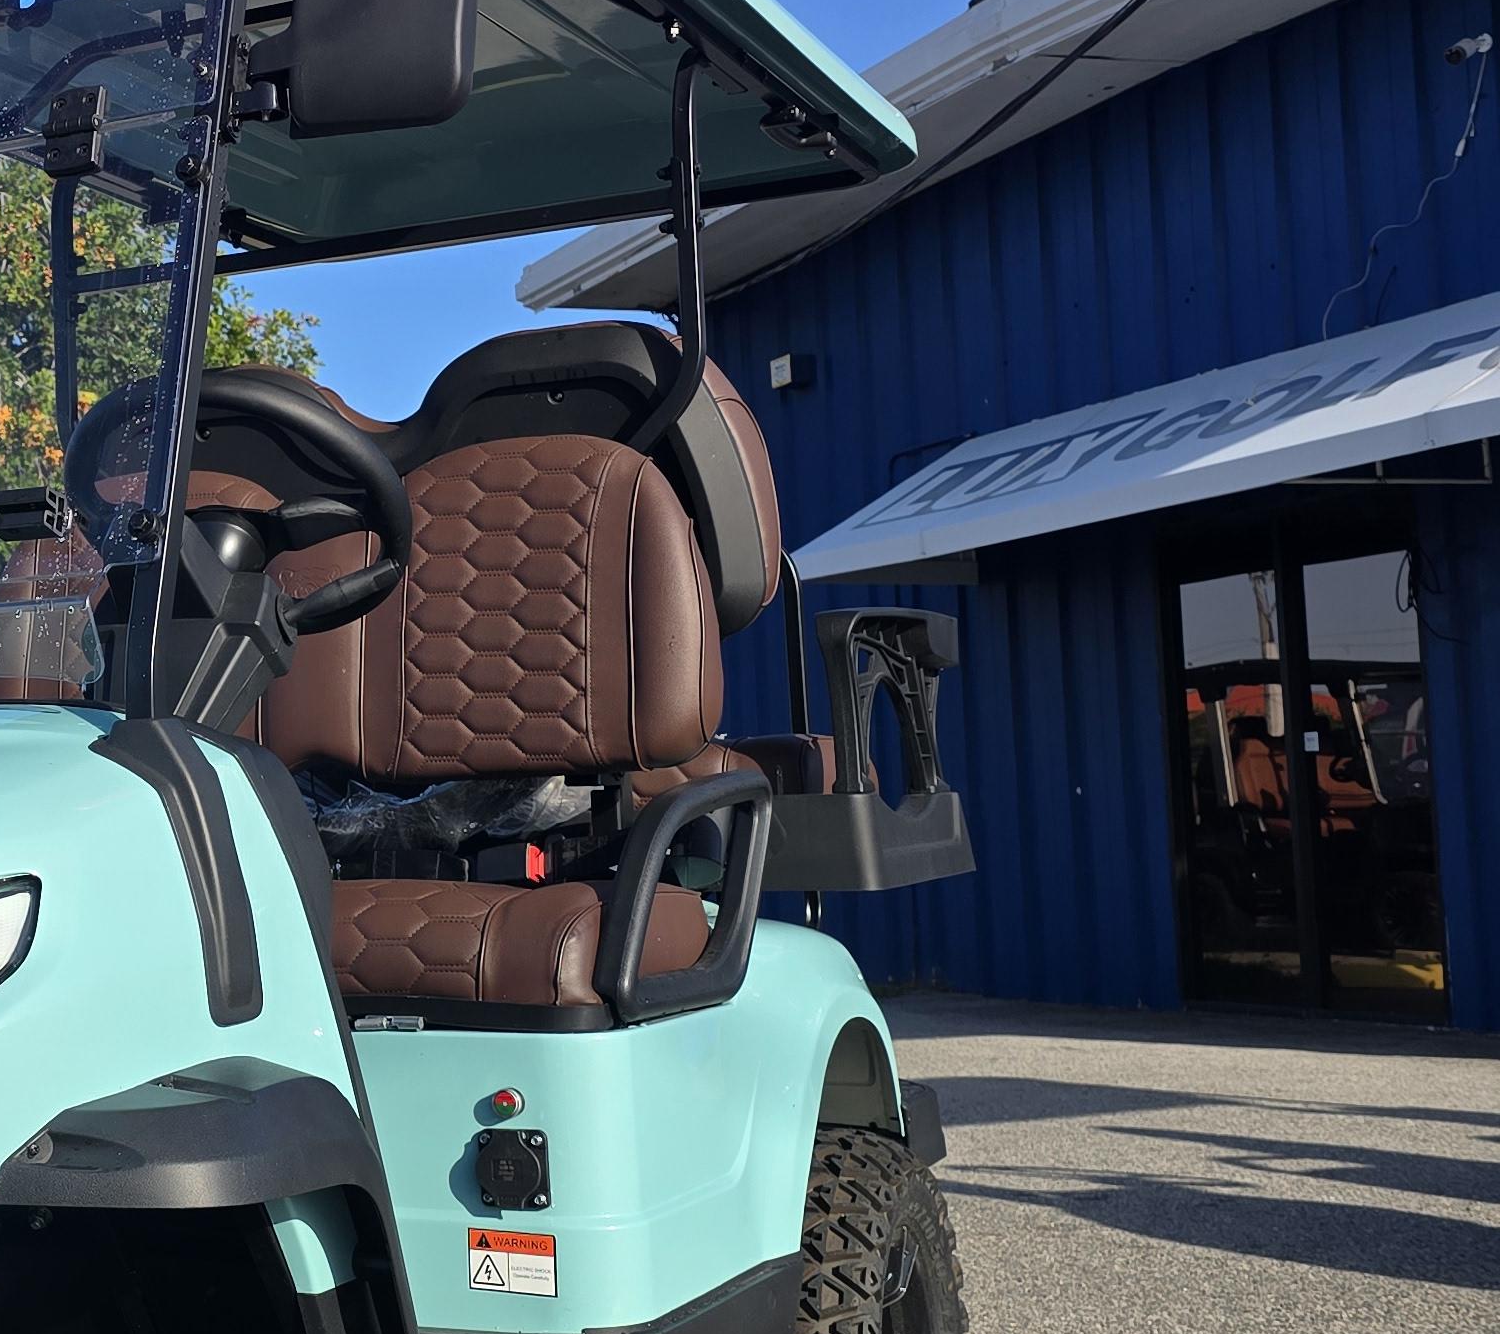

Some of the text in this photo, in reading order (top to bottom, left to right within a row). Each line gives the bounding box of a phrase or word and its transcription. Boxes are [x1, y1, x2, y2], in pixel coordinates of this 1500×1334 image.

[855, 326, 1500, 527] LUX GOLF
[493, 1236, 548, 1251] WARNING
